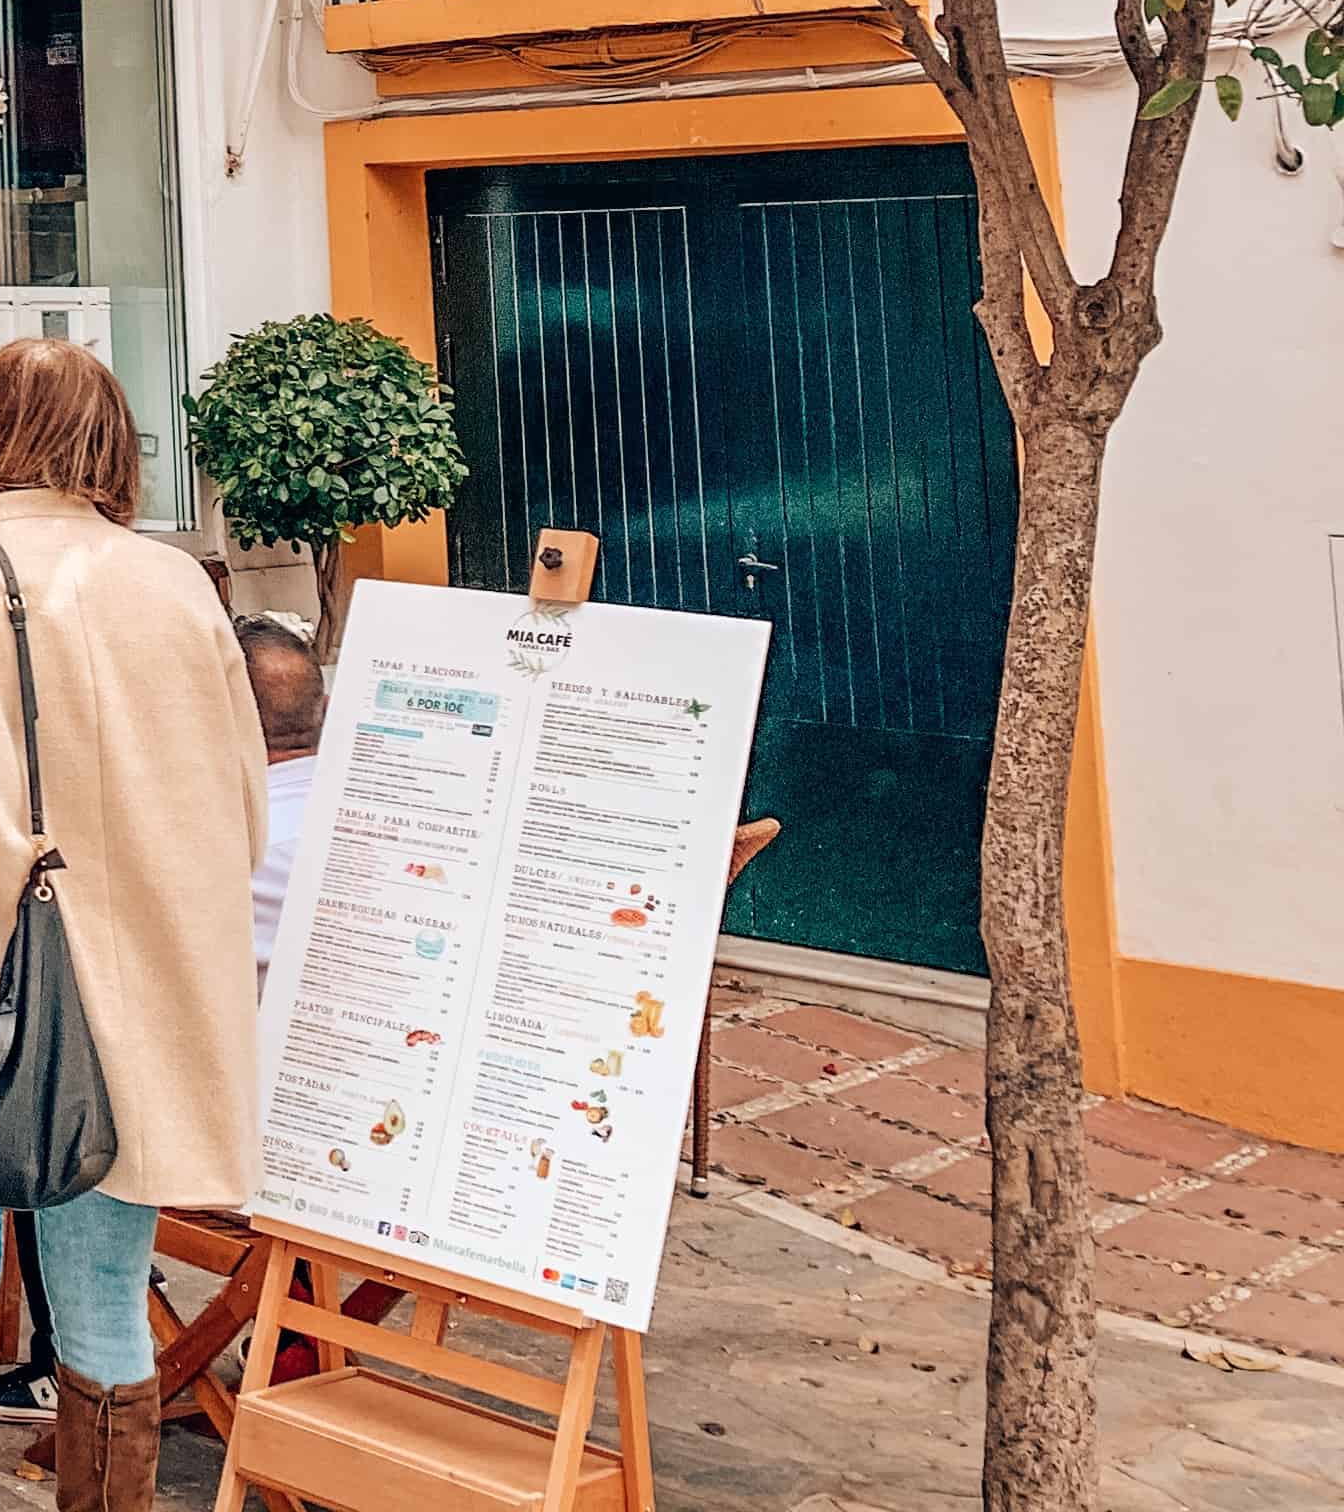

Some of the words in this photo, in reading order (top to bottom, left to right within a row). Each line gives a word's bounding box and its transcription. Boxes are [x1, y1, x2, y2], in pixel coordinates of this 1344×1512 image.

[506, 629, 534, 643] MIA
[537, 632, 574, 648] CAFÉ
[371, 658, 403, 671] TAPAS
[550, 680, 593, 695] VERDES
[600, 687, 609, 697] Y
[613, 689, 690, 708] SALUDABLES
[406, 696, 414, 707] 6
[416, 697, 441, 711] POR
[442, 701, 465, 714] 10€
[336, 806, 377, 822] TABLAS
[382, 814, 411, 828] PARA
[503, 912, 539, 928] ZUMOS
[293, 997, 335, 1017] PLATOS
